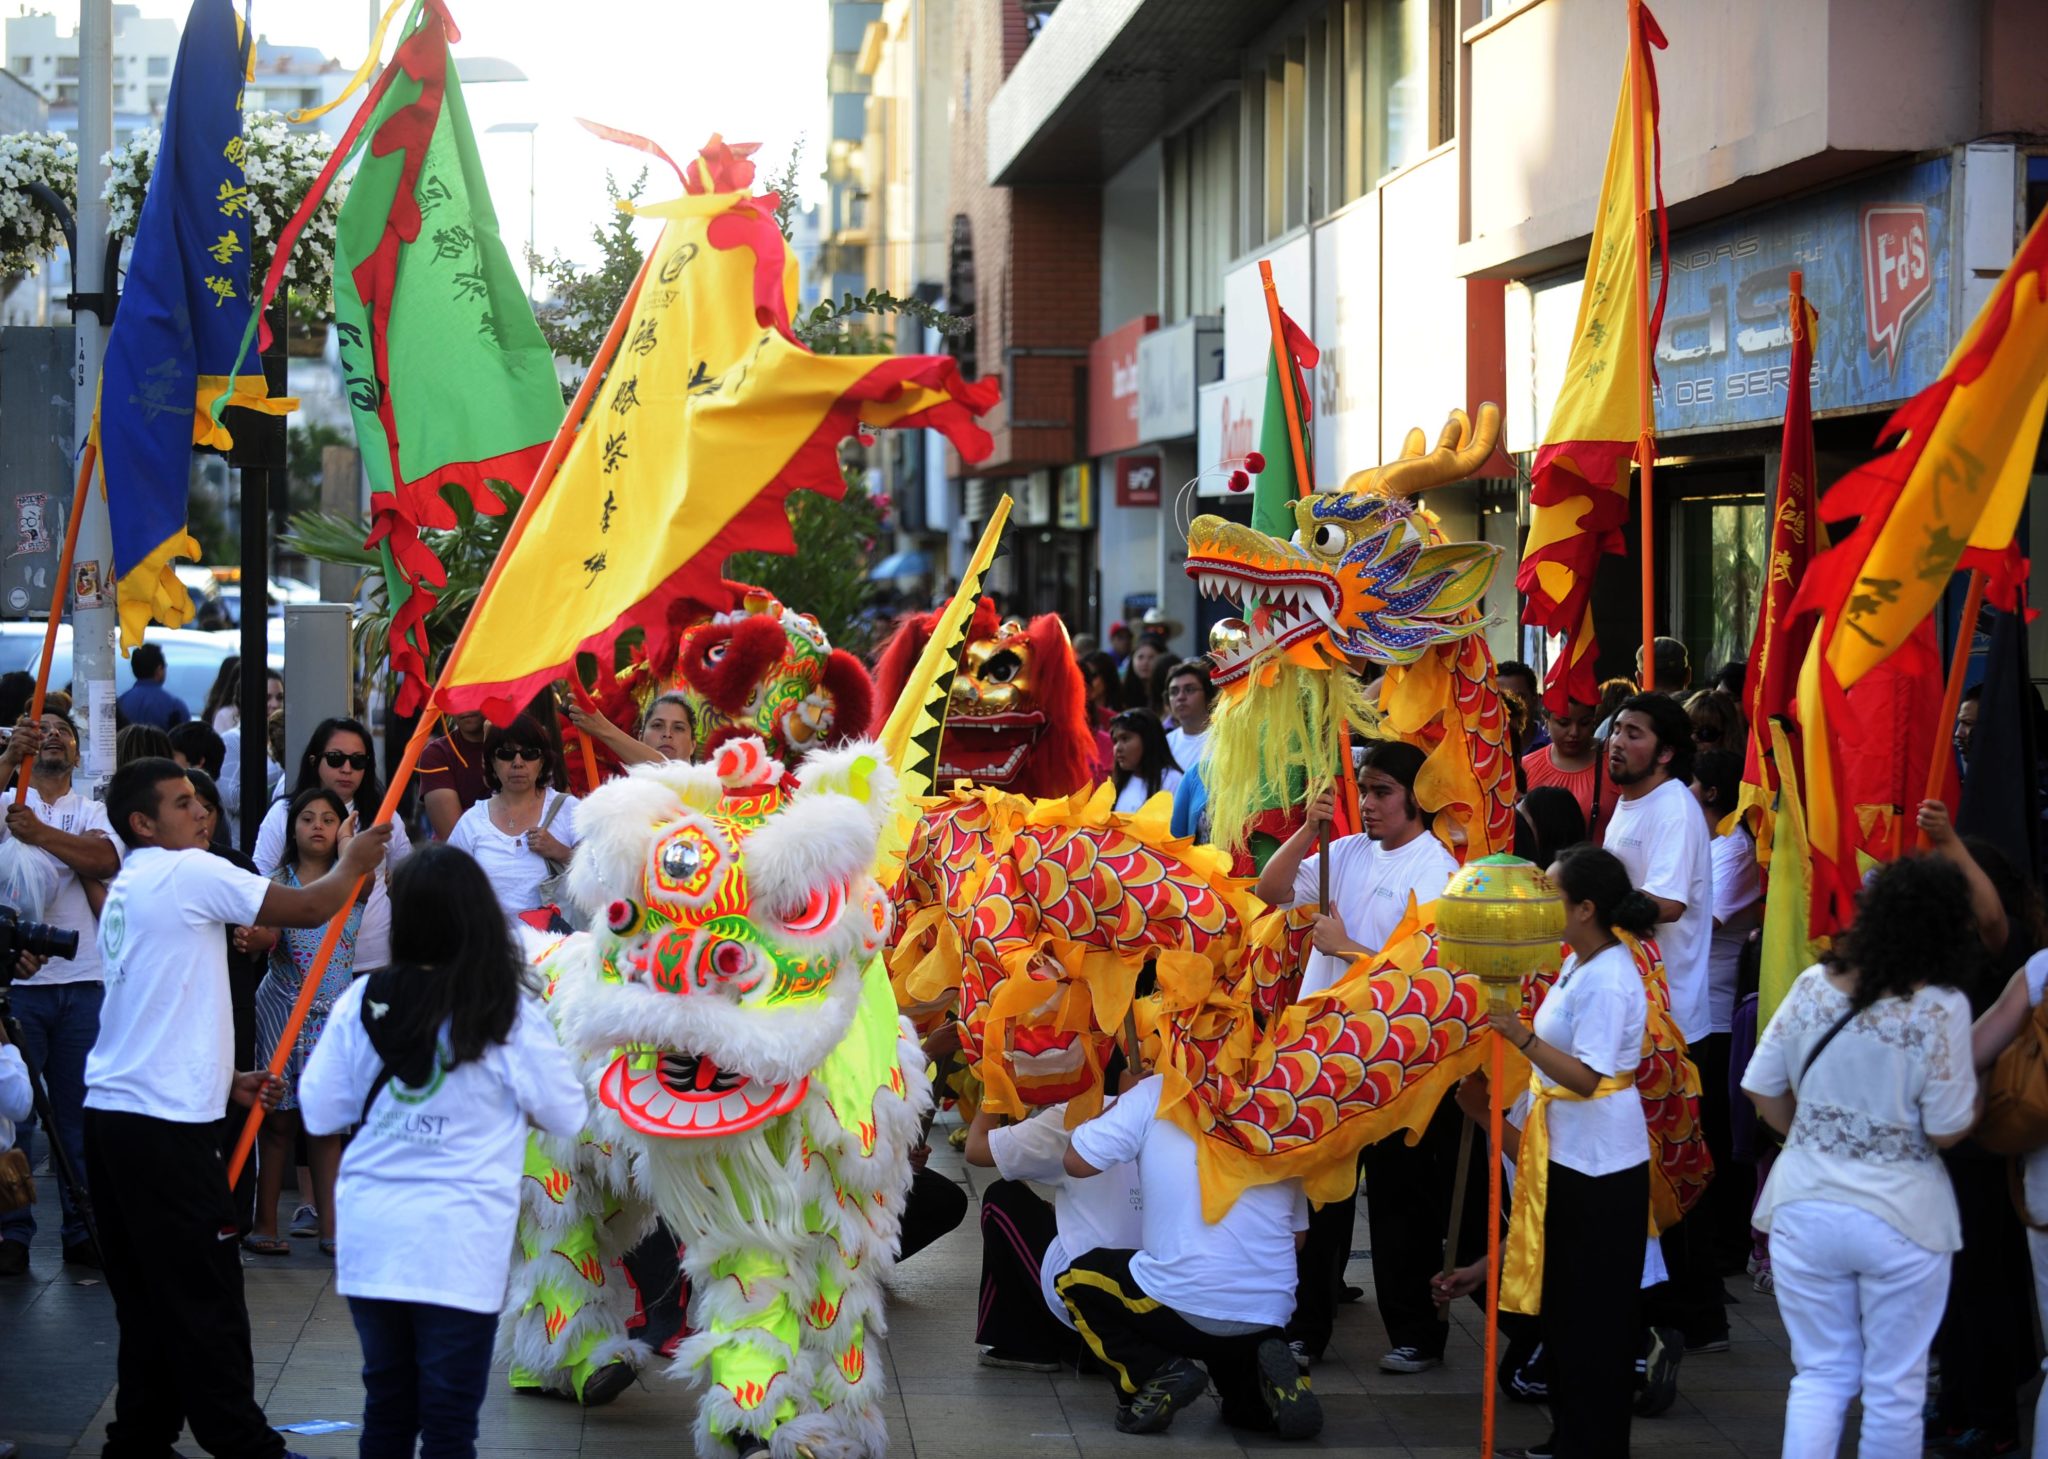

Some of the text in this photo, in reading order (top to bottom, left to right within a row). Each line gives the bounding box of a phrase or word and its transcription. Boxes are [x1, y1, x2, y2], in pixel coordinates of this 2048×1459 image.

[1878, 225, 1926, 304] FdS
[1676, 376, 1715, 407] DE
[1727, 360, 1821, 400] SERE
[405, 1113, 451, 1135] UST
